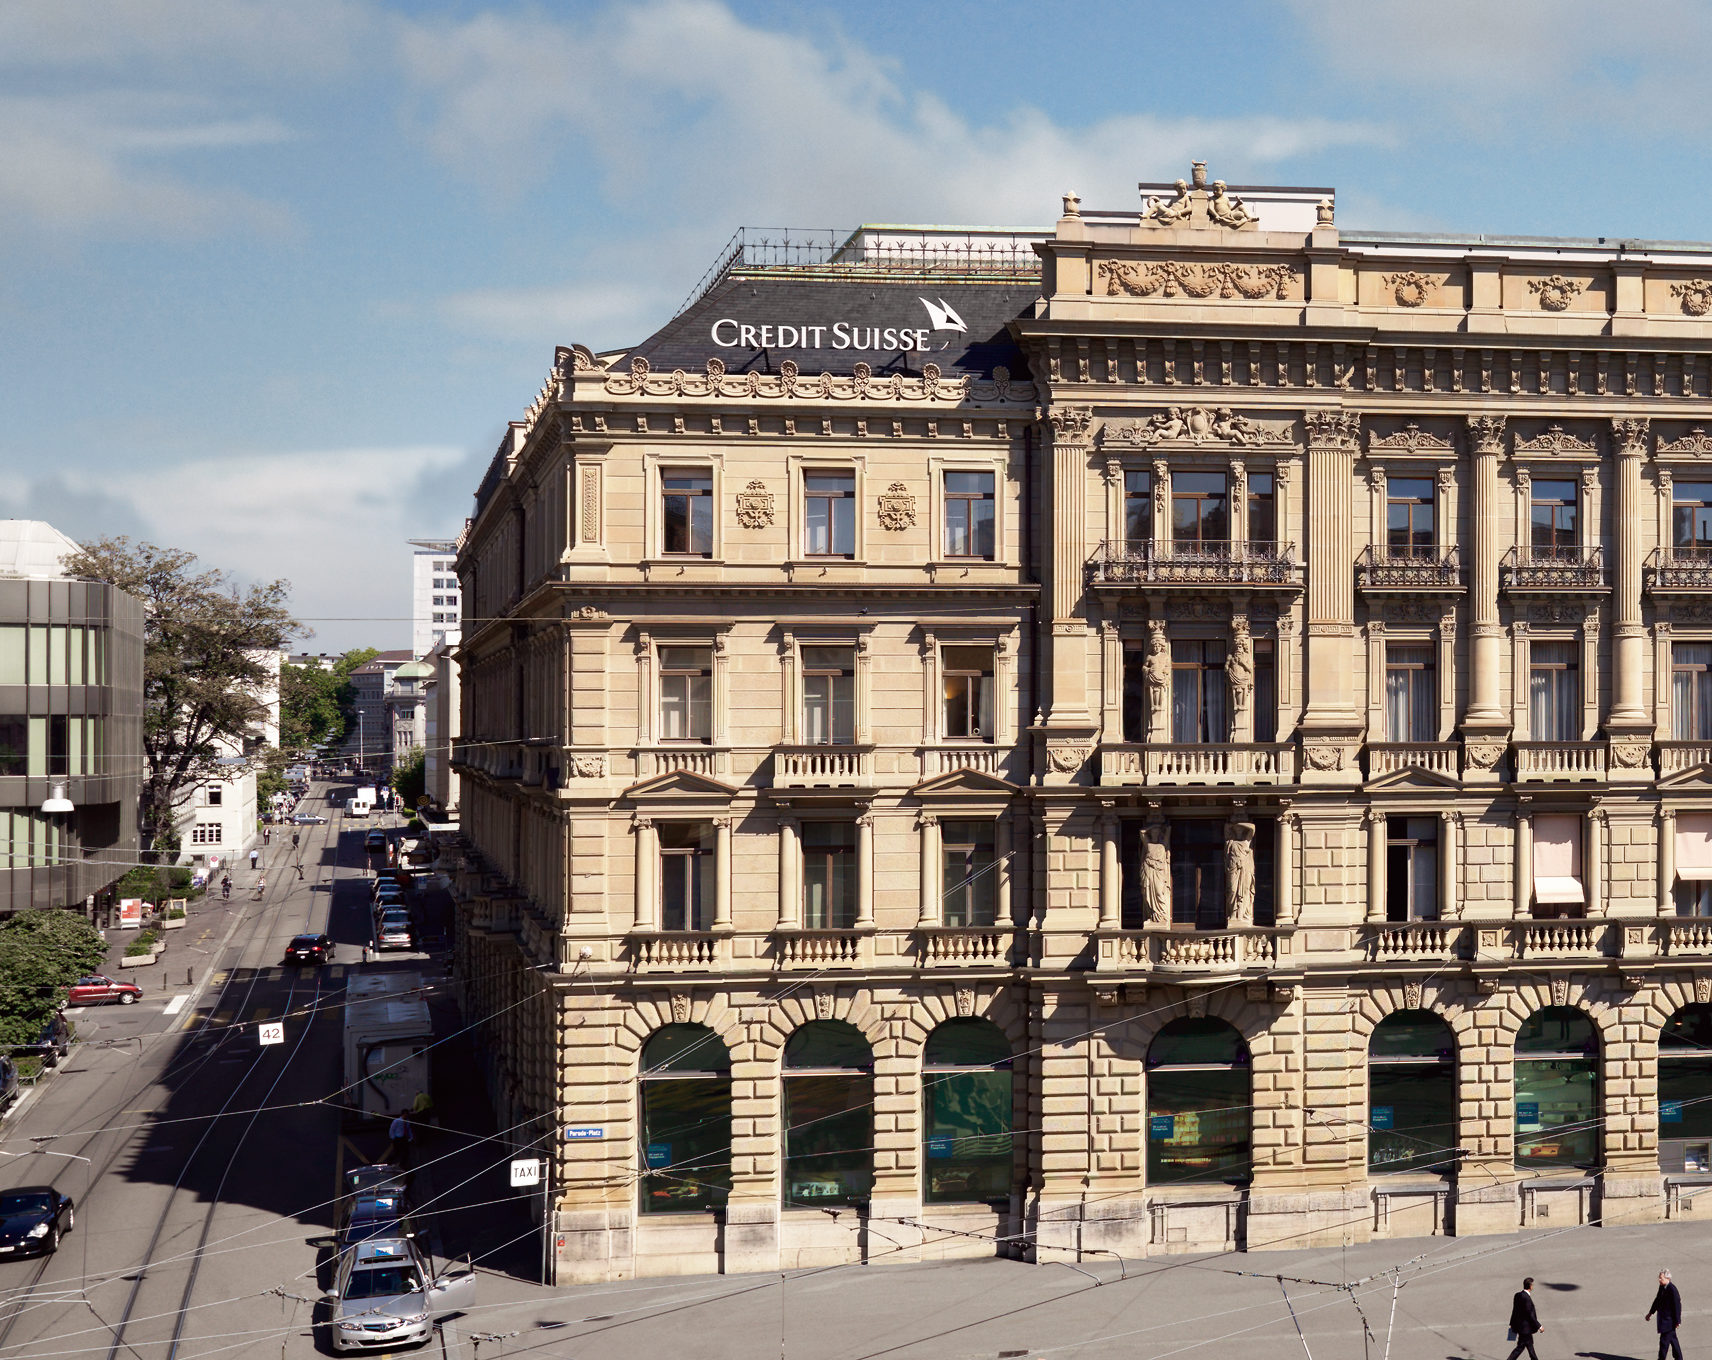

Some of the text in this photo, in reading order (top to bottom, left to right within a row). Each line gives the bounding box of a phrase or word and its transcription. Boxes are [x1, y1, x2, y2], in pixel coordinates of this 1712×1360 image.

[711, 318, 931, 351] CREDIT SUISSE
[262, 1028, 281, 1040] 42
[513, 1166, 537, 1178] TAXI
